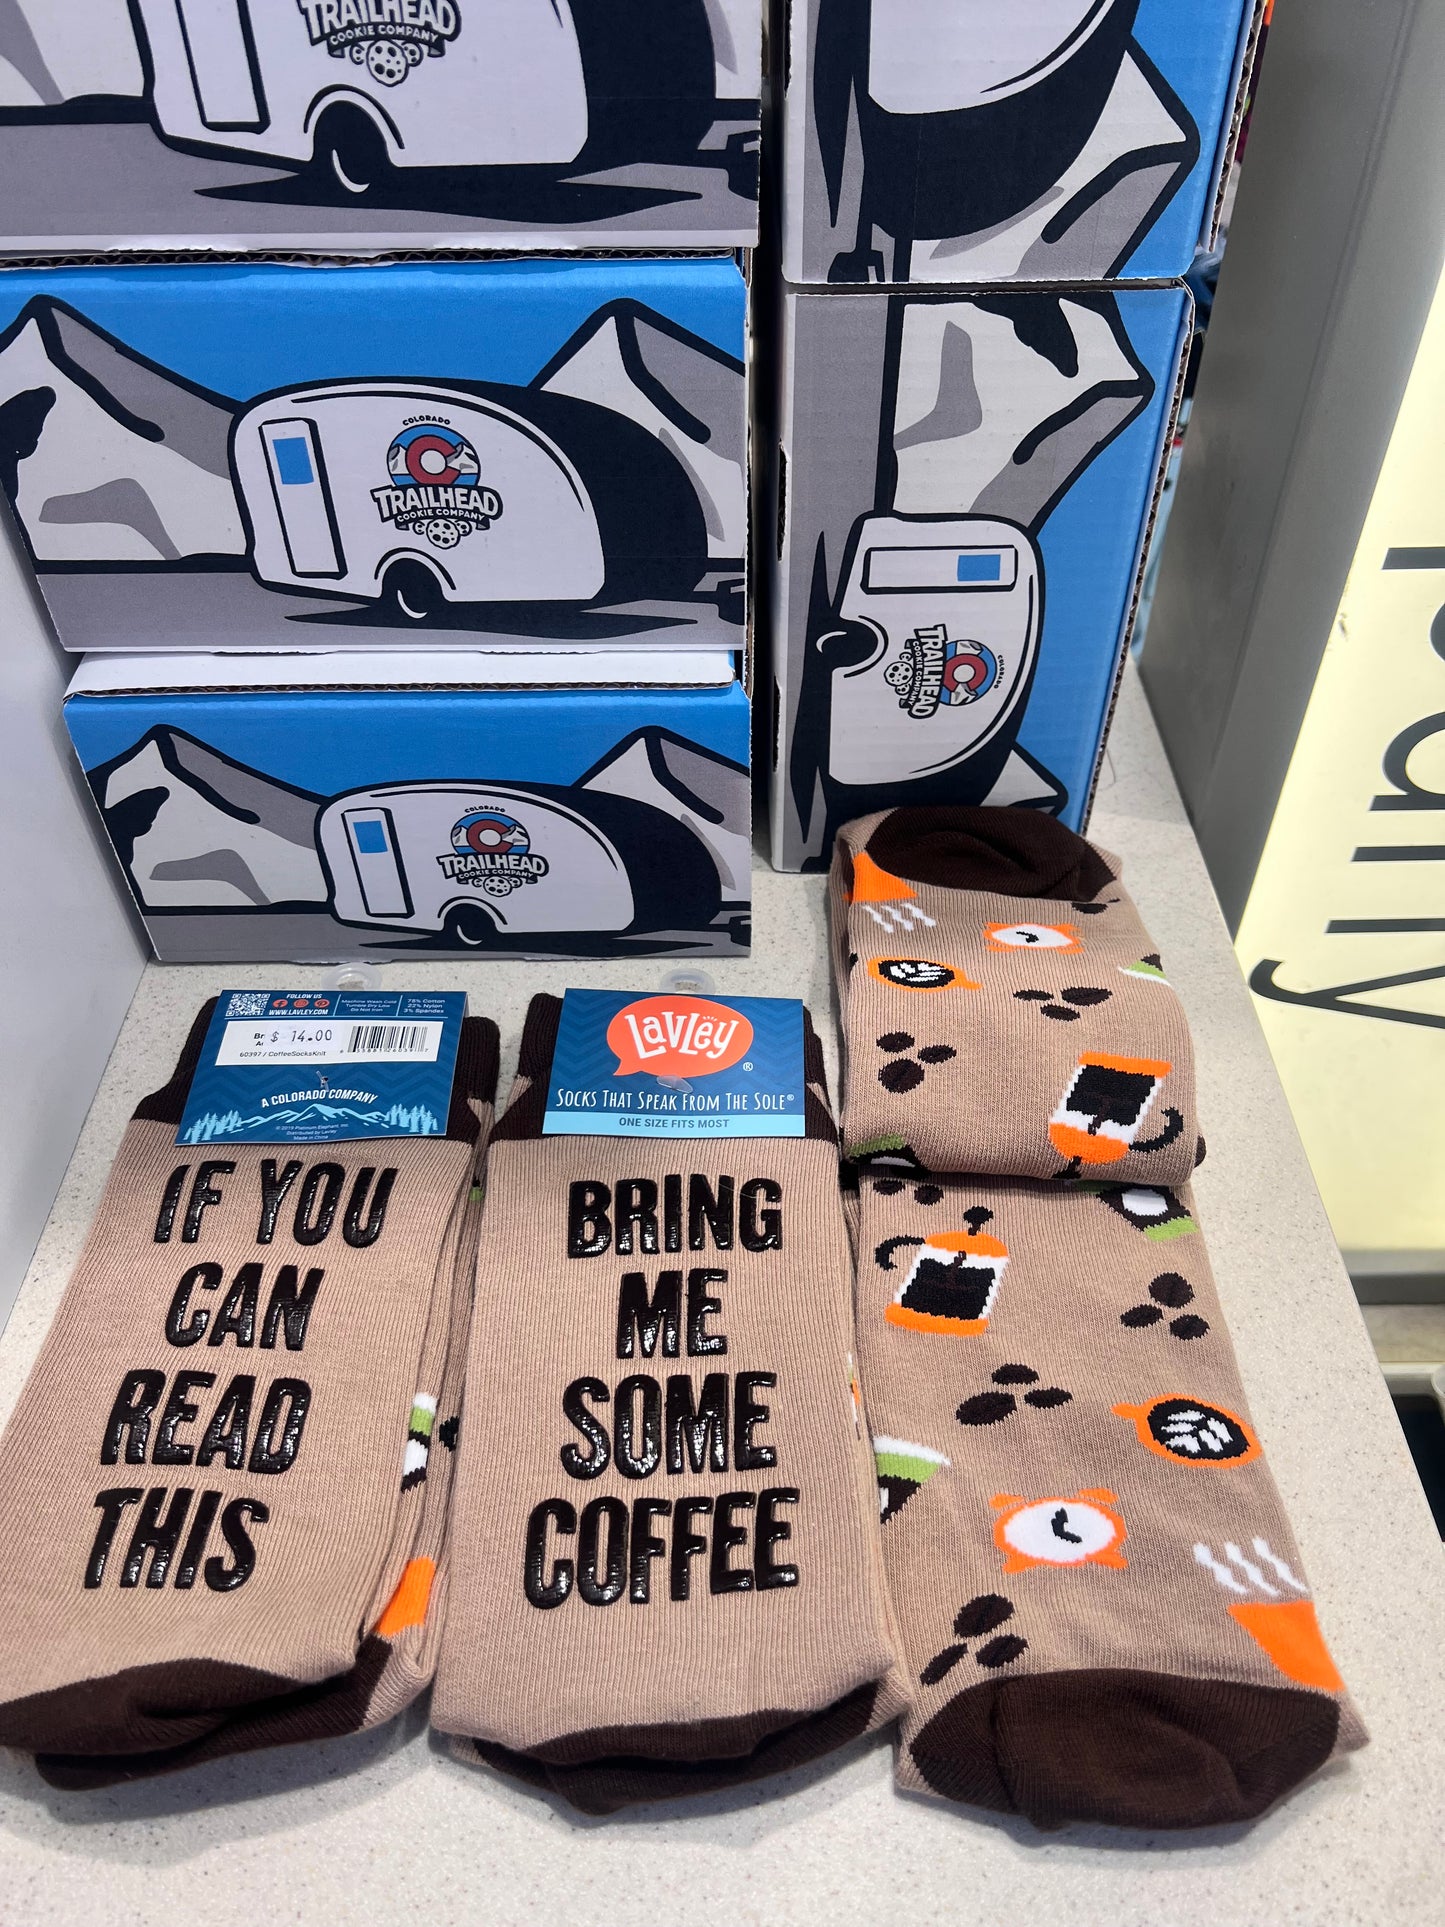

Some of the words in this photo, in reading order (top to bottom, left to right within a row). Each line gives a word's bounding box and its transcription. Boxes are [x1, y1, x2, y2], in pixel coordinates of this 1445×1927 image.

[301, 0, 457, 40] TRAILHEAD
[330, 25, 375, 45] COOKIE
[378, 24, 438, 43] COMPANY
[402, 415, 451, 426] COLORADO
[373, 486, 499, 518] TRAILHEAD
[396, 508, 434, 522] COOKIE
[436, 508, 486, 522] COMPANY
[911, 626, 945, 716] TRAILHEAD
[913, 640, 924, 670] COOKIE
[994, 654, 1005, 689] COLORADO
[908, 671, 922, 706] COMPANY
[464, 805, 506, 813] COLORADO
[439, 854, 546, 876] TRAILHEAD
[458, 869, 490, 879] COOKIE
[492, 869, 534, 878] COMPANY
[291, 1029, 332, 1042] 14.00
[262, 1098, 270, 1108] A
[271, 1090, 326, 1106] COLORADO
[328, 1089, 378, 1104] COMPANY
[602, 1089, 632, 1110] THAT
[638, 1091, 678, 1111] SPEAK
[682, 1093, 720, 1112] FROM
[726, 1093, 748, 1110] THE
[619, 1117, 642, 1128] ONE
[644, 1119, 668, 1128] SIZE
[671, 1119, 695, 1128] FITS
[698, 1119, 730, 1129] MOST
[153, 1159, 236, 1244] IF
[256, 1158, 398, 1249] YOU
[567, 1173, 784, 1260] BRING
[164, 1262, 326, 1352] CAN
[616, 1268, 728, 1360] ME
[100, 1369, 312, 1475] READ
[560, 1372, 778, 1481] SOME
[84, 1486, 271, 1592] THIS
[523, 1487, 801, 1610] COFFEE
